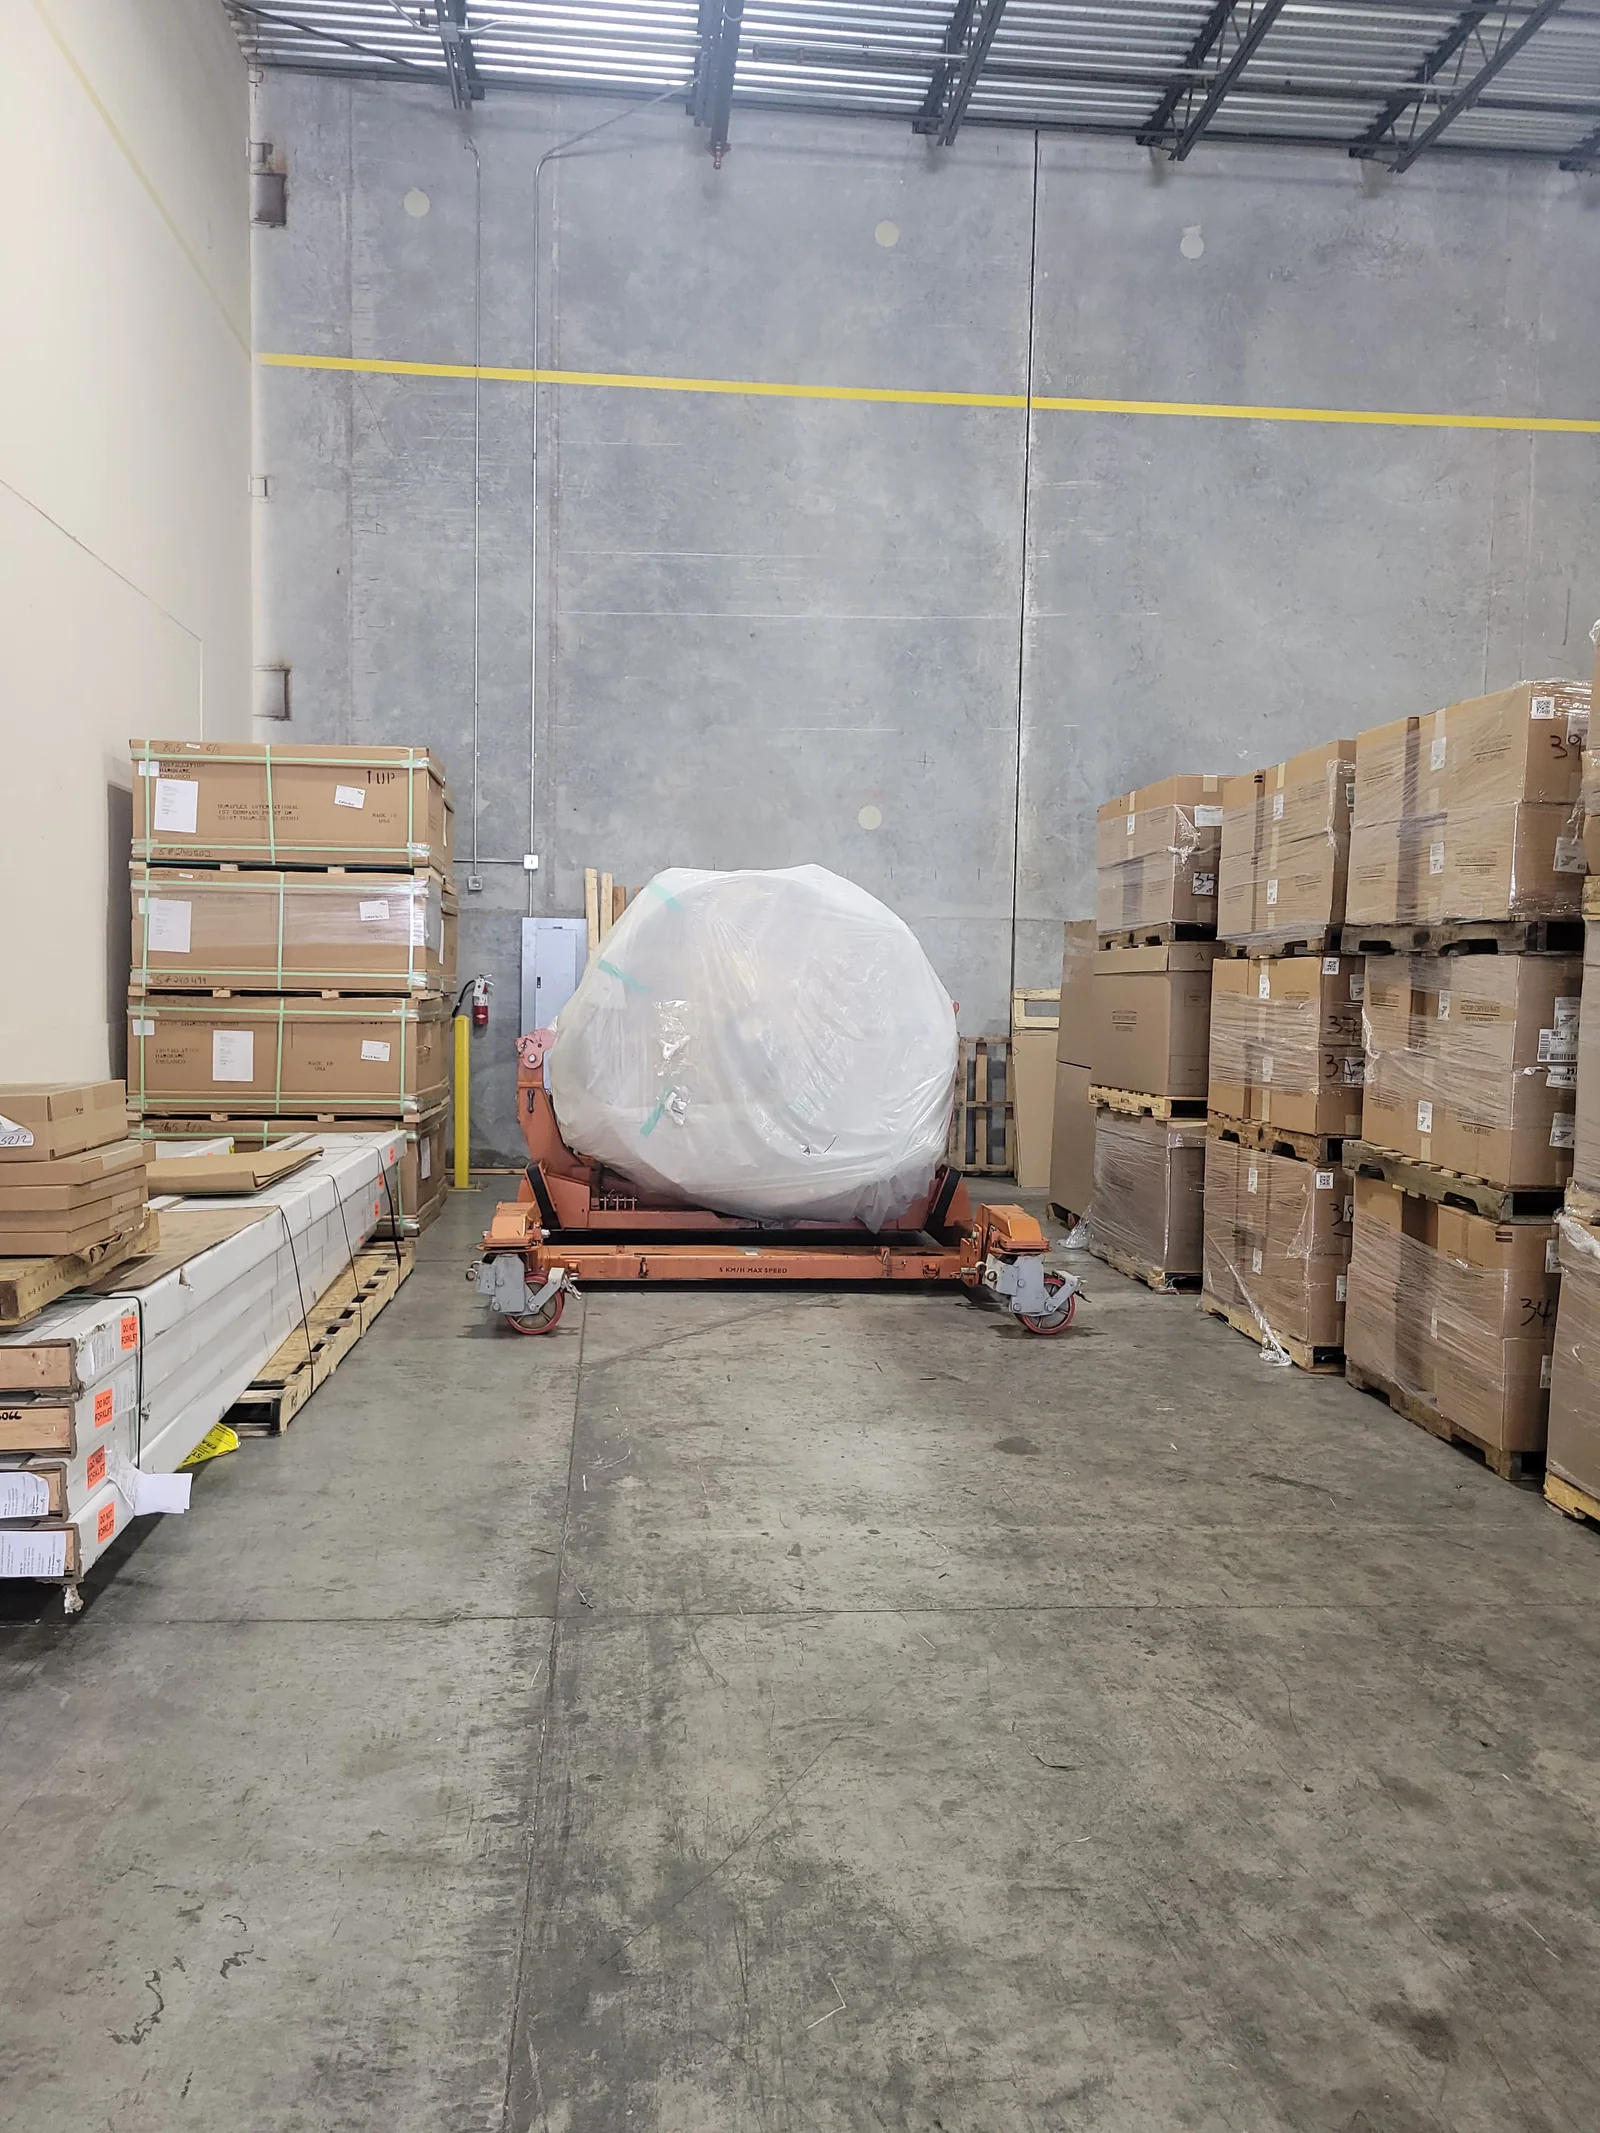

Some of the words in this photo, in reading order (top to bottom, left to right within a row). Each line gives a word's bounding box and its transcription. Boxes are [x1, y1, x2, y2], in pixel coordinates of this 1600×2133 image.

[1550, 735, 1582, 760] 39
[376, 772, 396, 784] UP
[0, 1410, 22, 1420] 066
